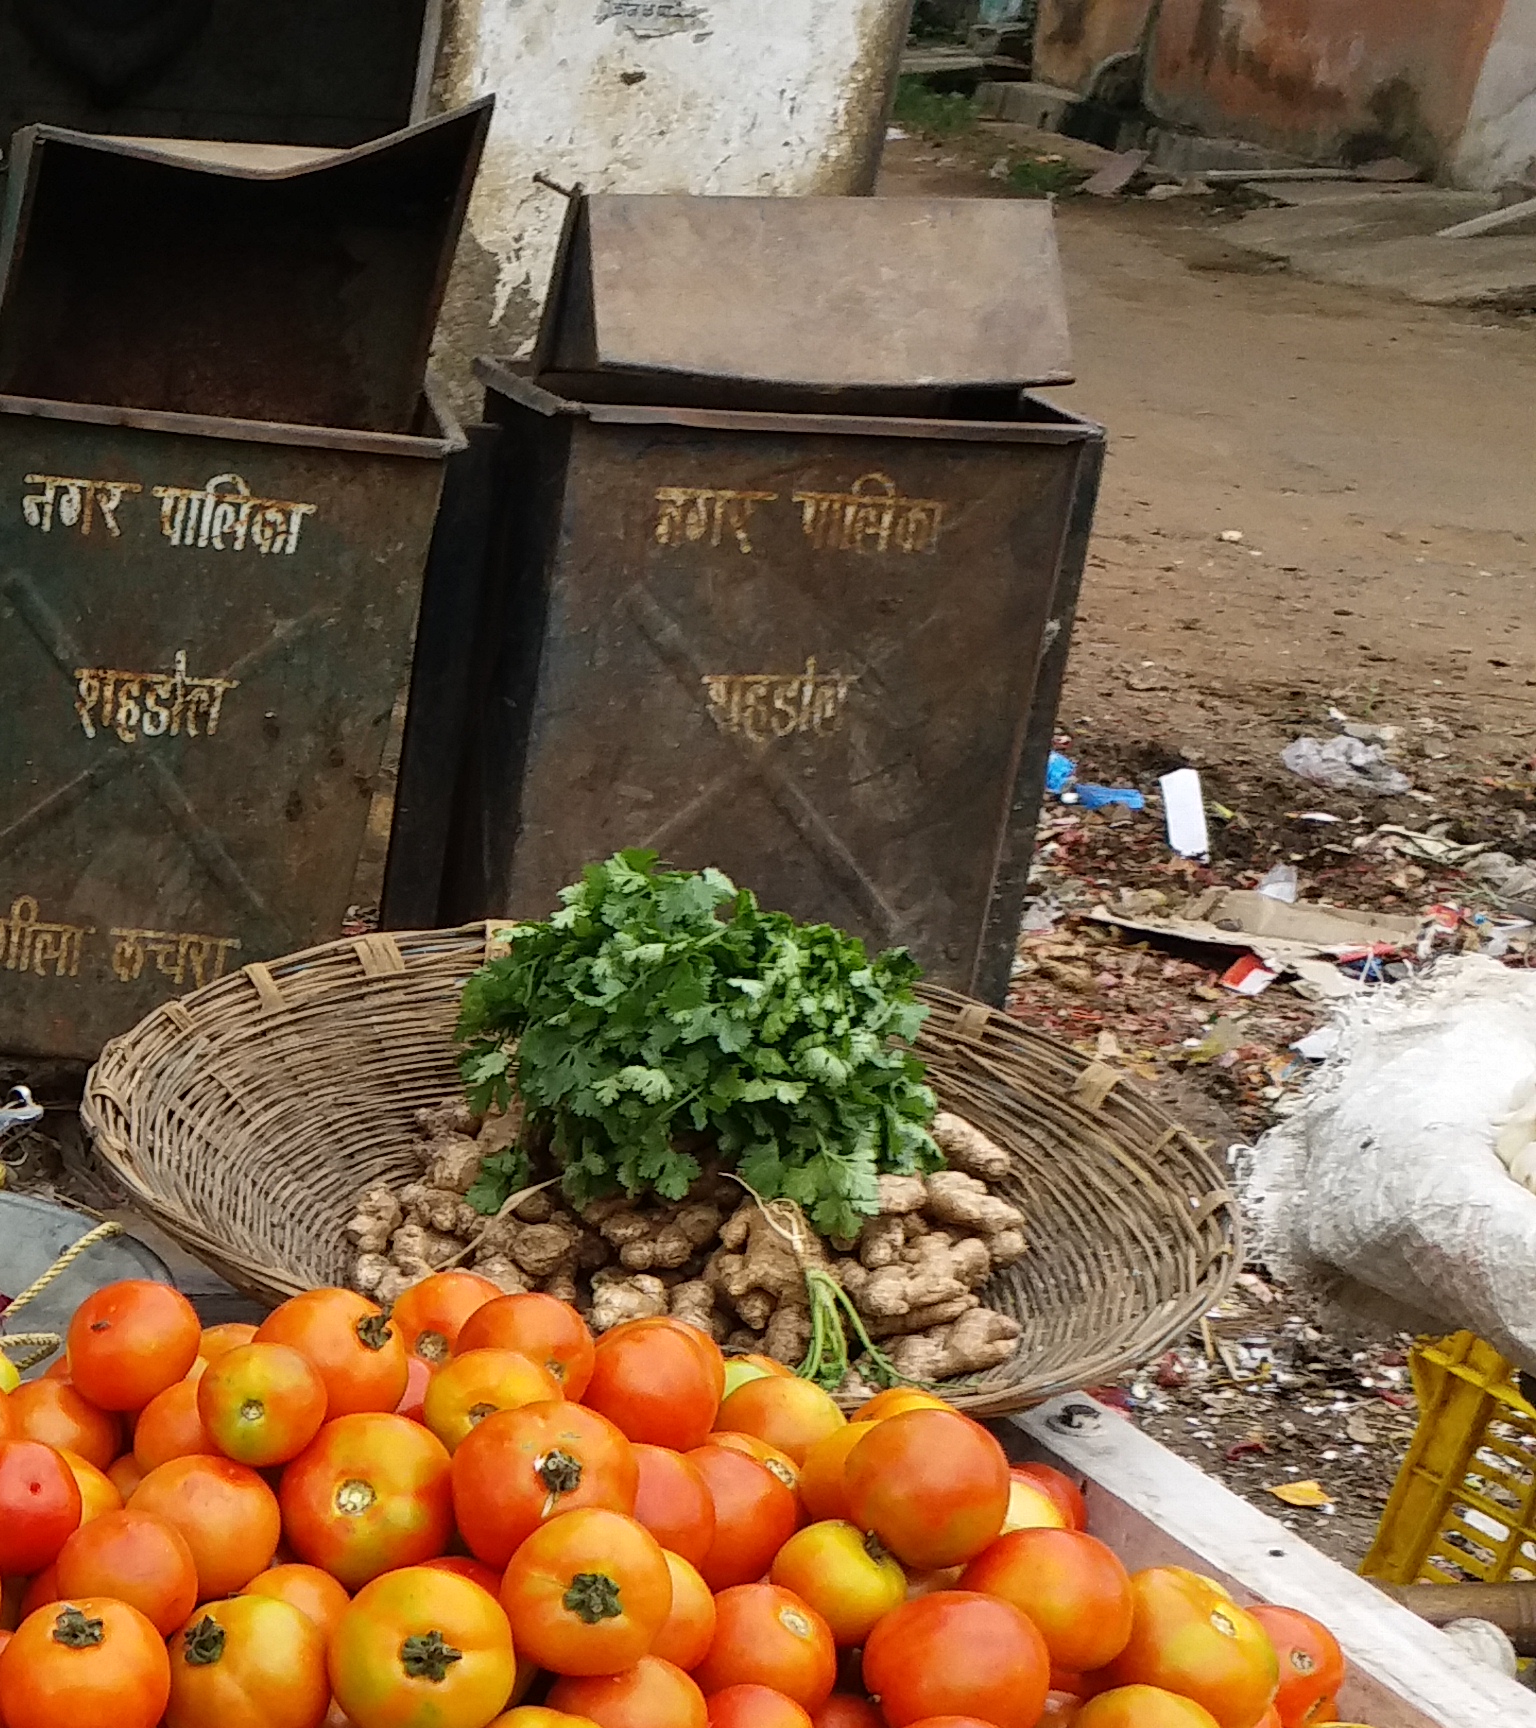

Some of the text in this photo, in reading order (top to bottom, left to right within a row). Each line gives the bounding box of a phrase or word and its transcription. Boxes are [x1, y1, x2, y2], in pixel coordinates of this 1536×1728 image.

[23, 472, 319, 556] नगर पालिका
[655, 486, 778, 554] नगर
[74, 650, 241, 743] शहडोल
[110, 927, 242, 989] कचरा
